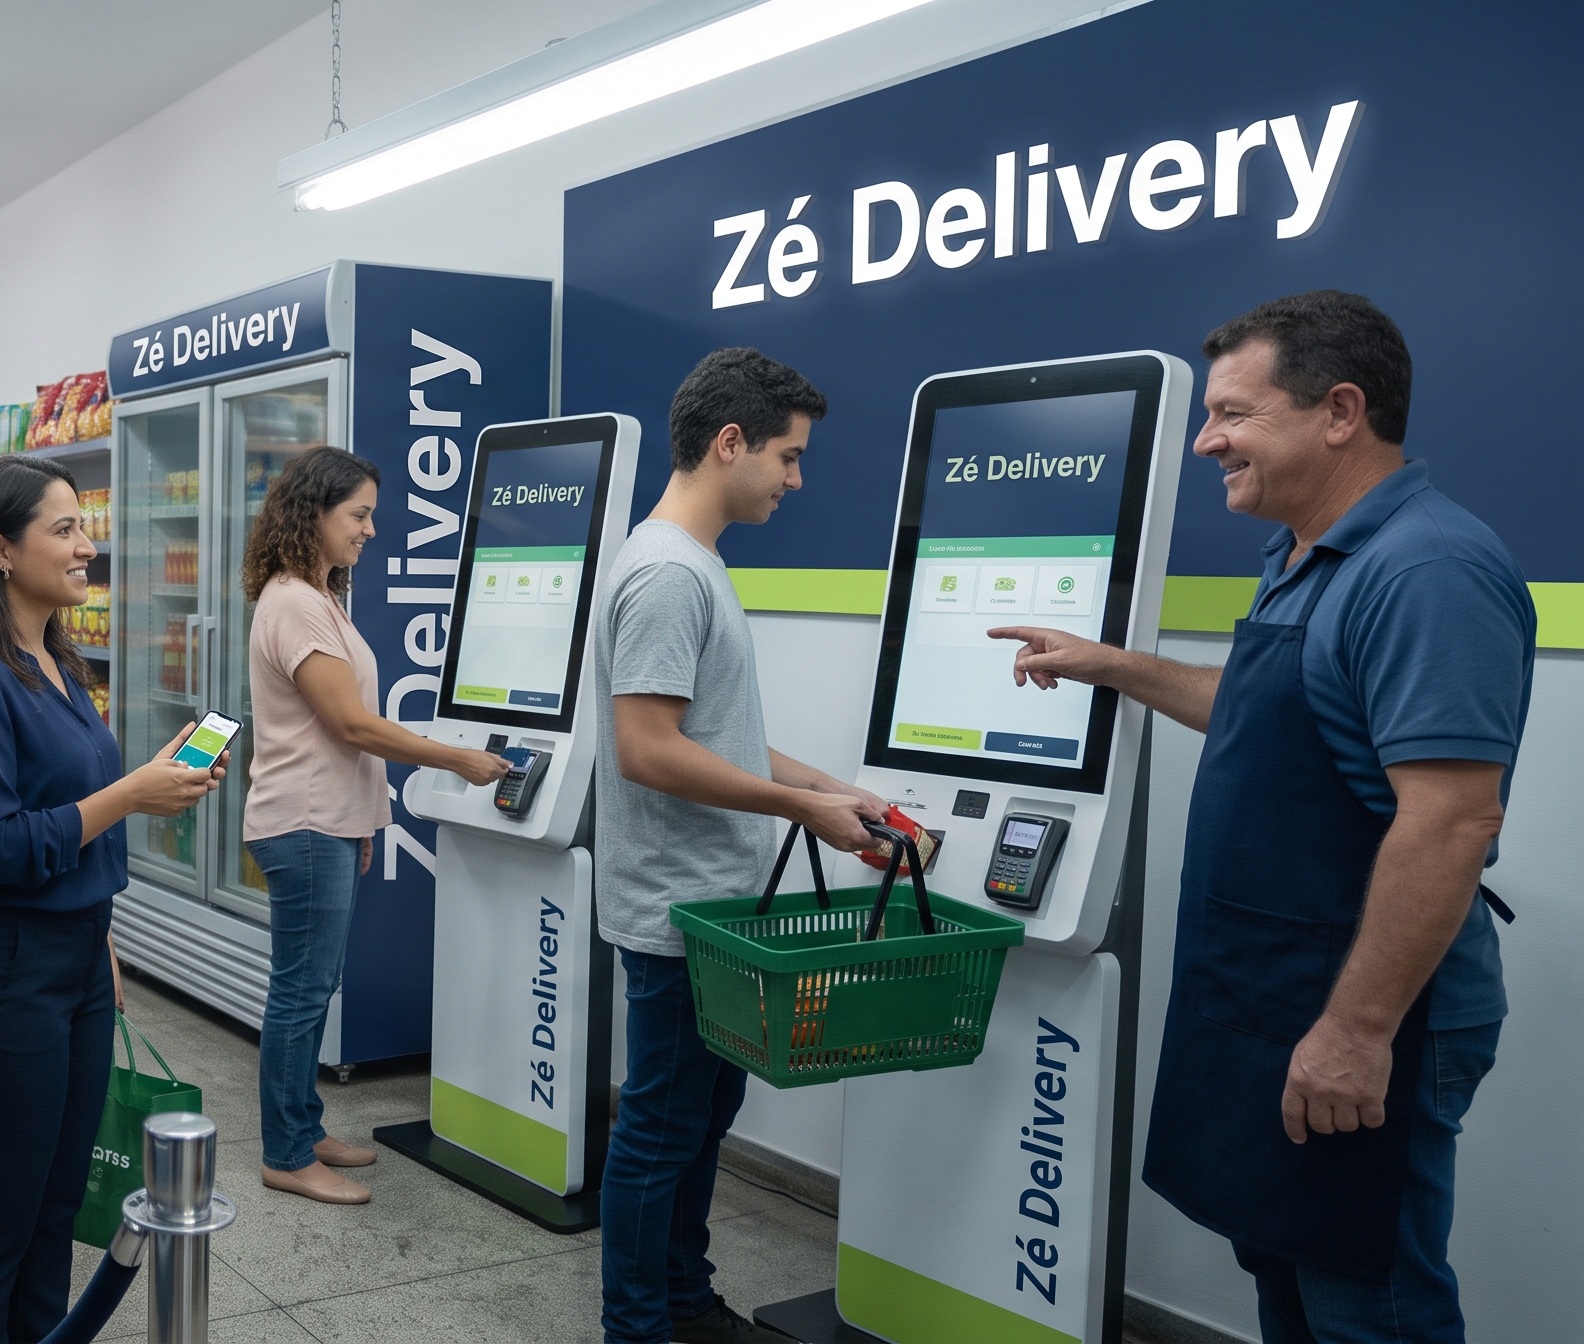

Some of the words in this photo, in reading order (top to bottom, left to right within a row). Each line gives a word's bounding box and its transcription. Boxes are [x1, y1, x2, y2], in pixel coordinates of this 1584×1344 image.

[711, 194, 823, 310] Zé
[851, 99, 1364, 285] Delivery
[132, 330, 164, 377] Zé
[173, 301, 301, 367] Delivery
[491, 485, 512, 506] Zé
[516, 483, 585, 507] Delivery
[945, 455, 979, 483] Zé
[987, 451, 1106, 483] Delivery
[531, 895, 565, 1052] Delivery
[530, 1059, 555, 1110] Zé
[1018, 1016, 1080, 1229] Delivery
[1014, 1233, 1059, 1306] Zé
